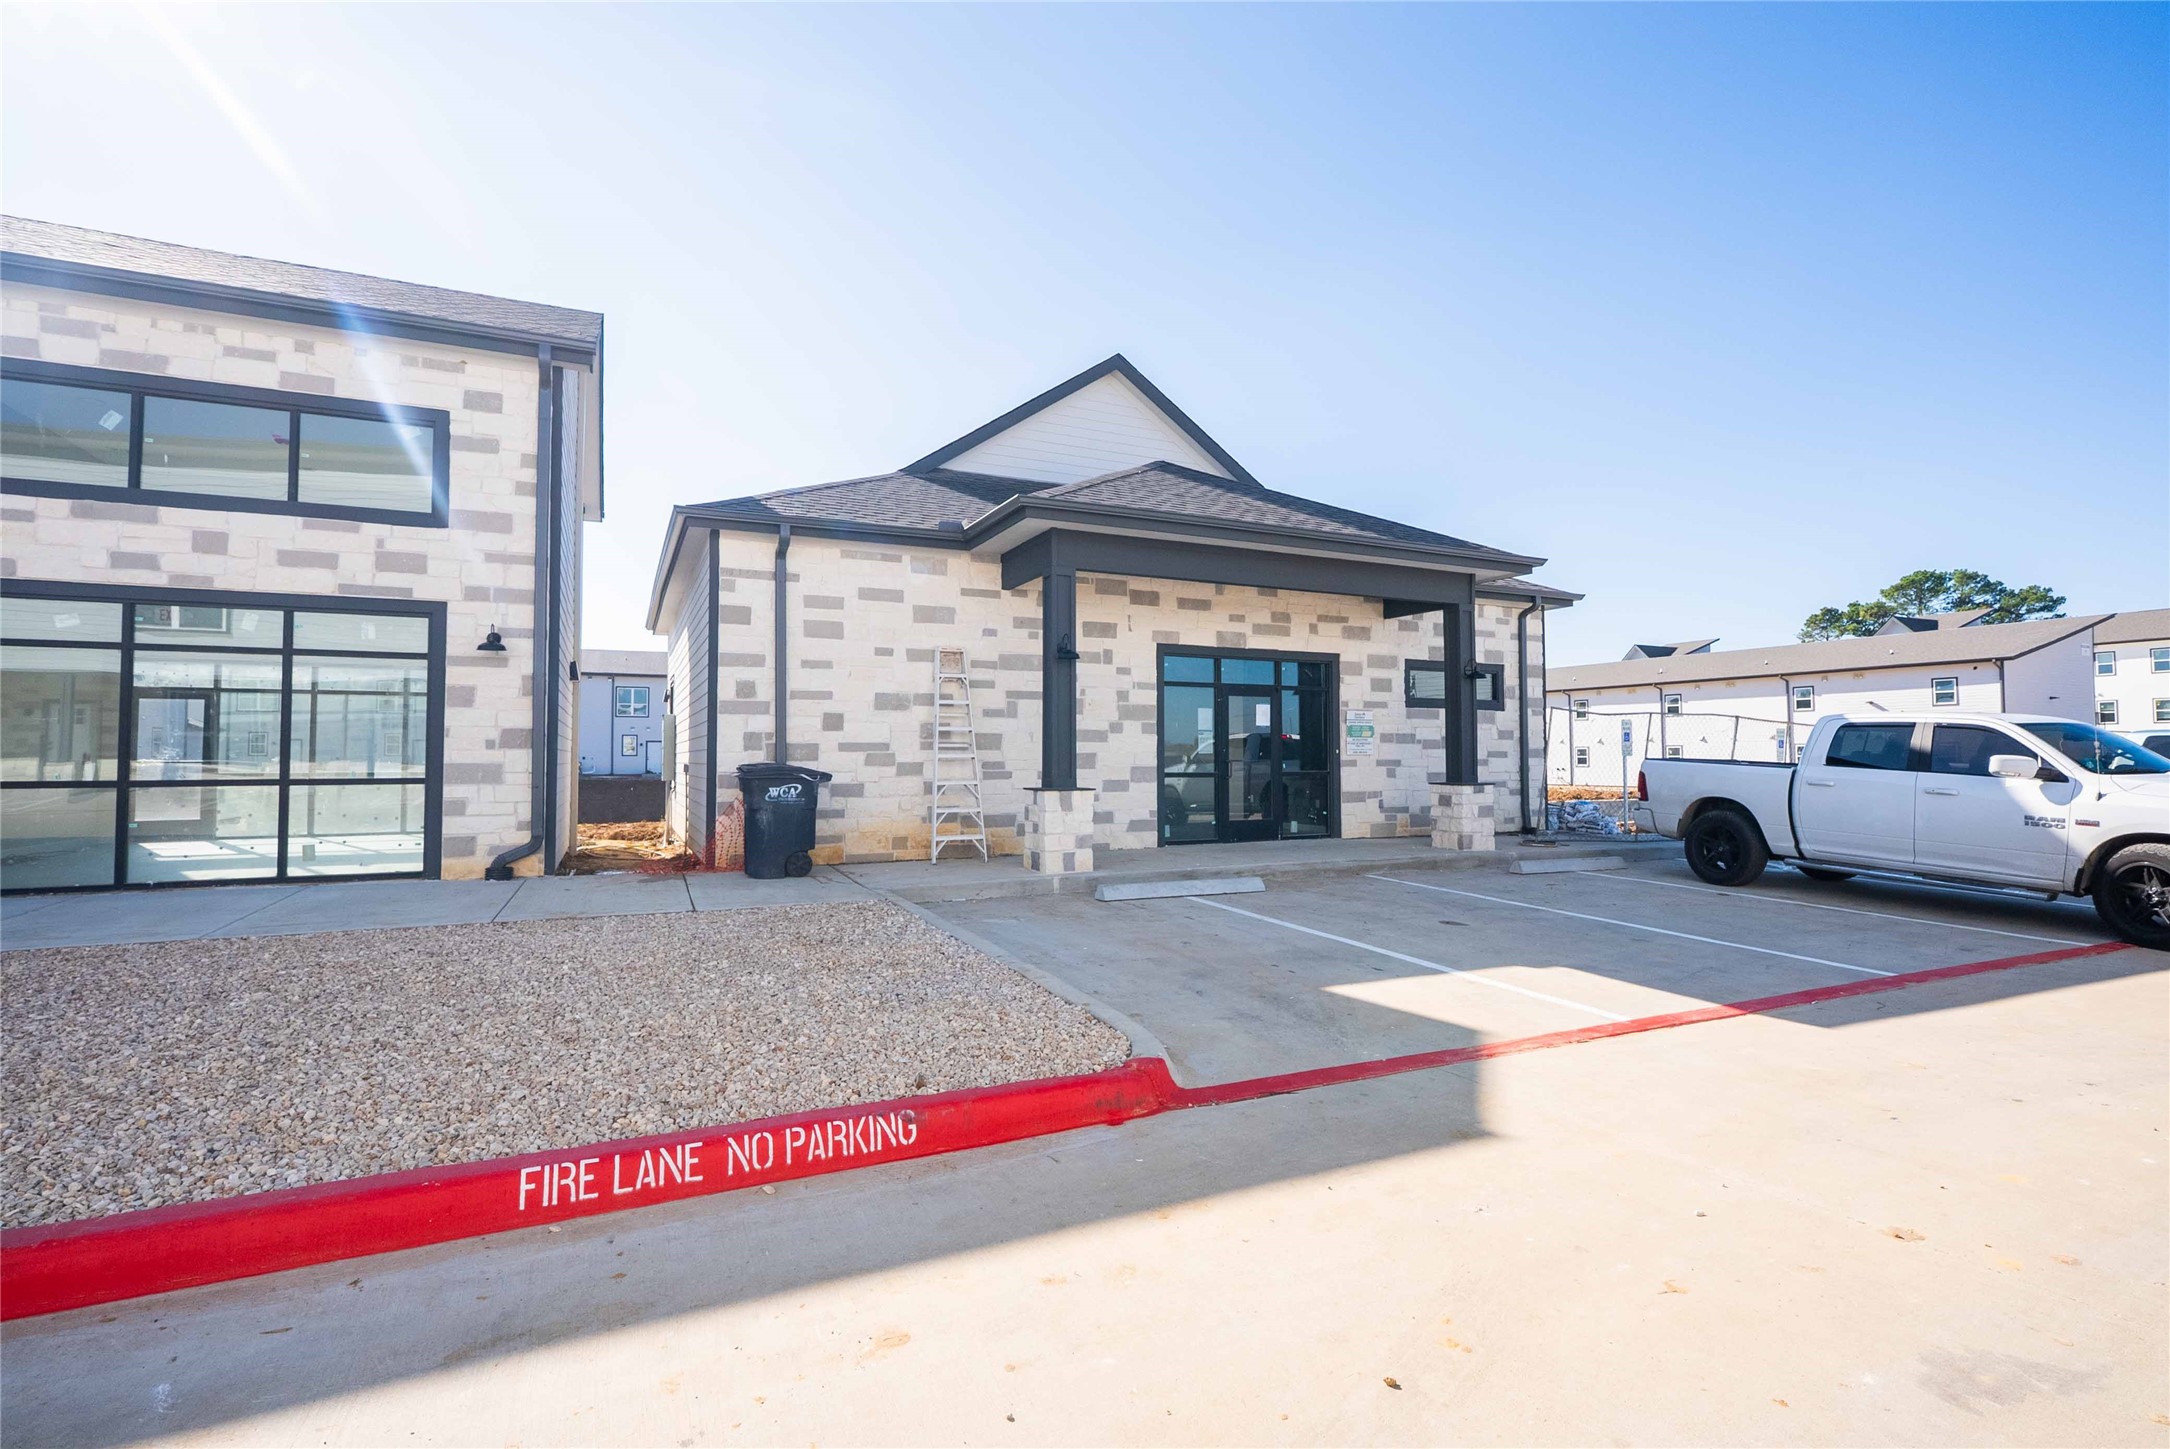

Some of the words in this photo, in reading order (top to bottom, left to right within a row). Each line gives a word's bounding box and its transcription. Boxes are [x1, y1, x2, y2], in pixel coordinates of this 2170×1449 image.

[768, 787, 797, 798] WCA
[2024, 815, 2066, 823] RAM
[2024, 820, 2066, 829] 1500
[519, 1158, 599, 1210] FIRE
[613, 1142, 703, 1194] LANE
[727, 1131, 774, 1176] NO
[786, 1110, 917, 1164] PARKING
